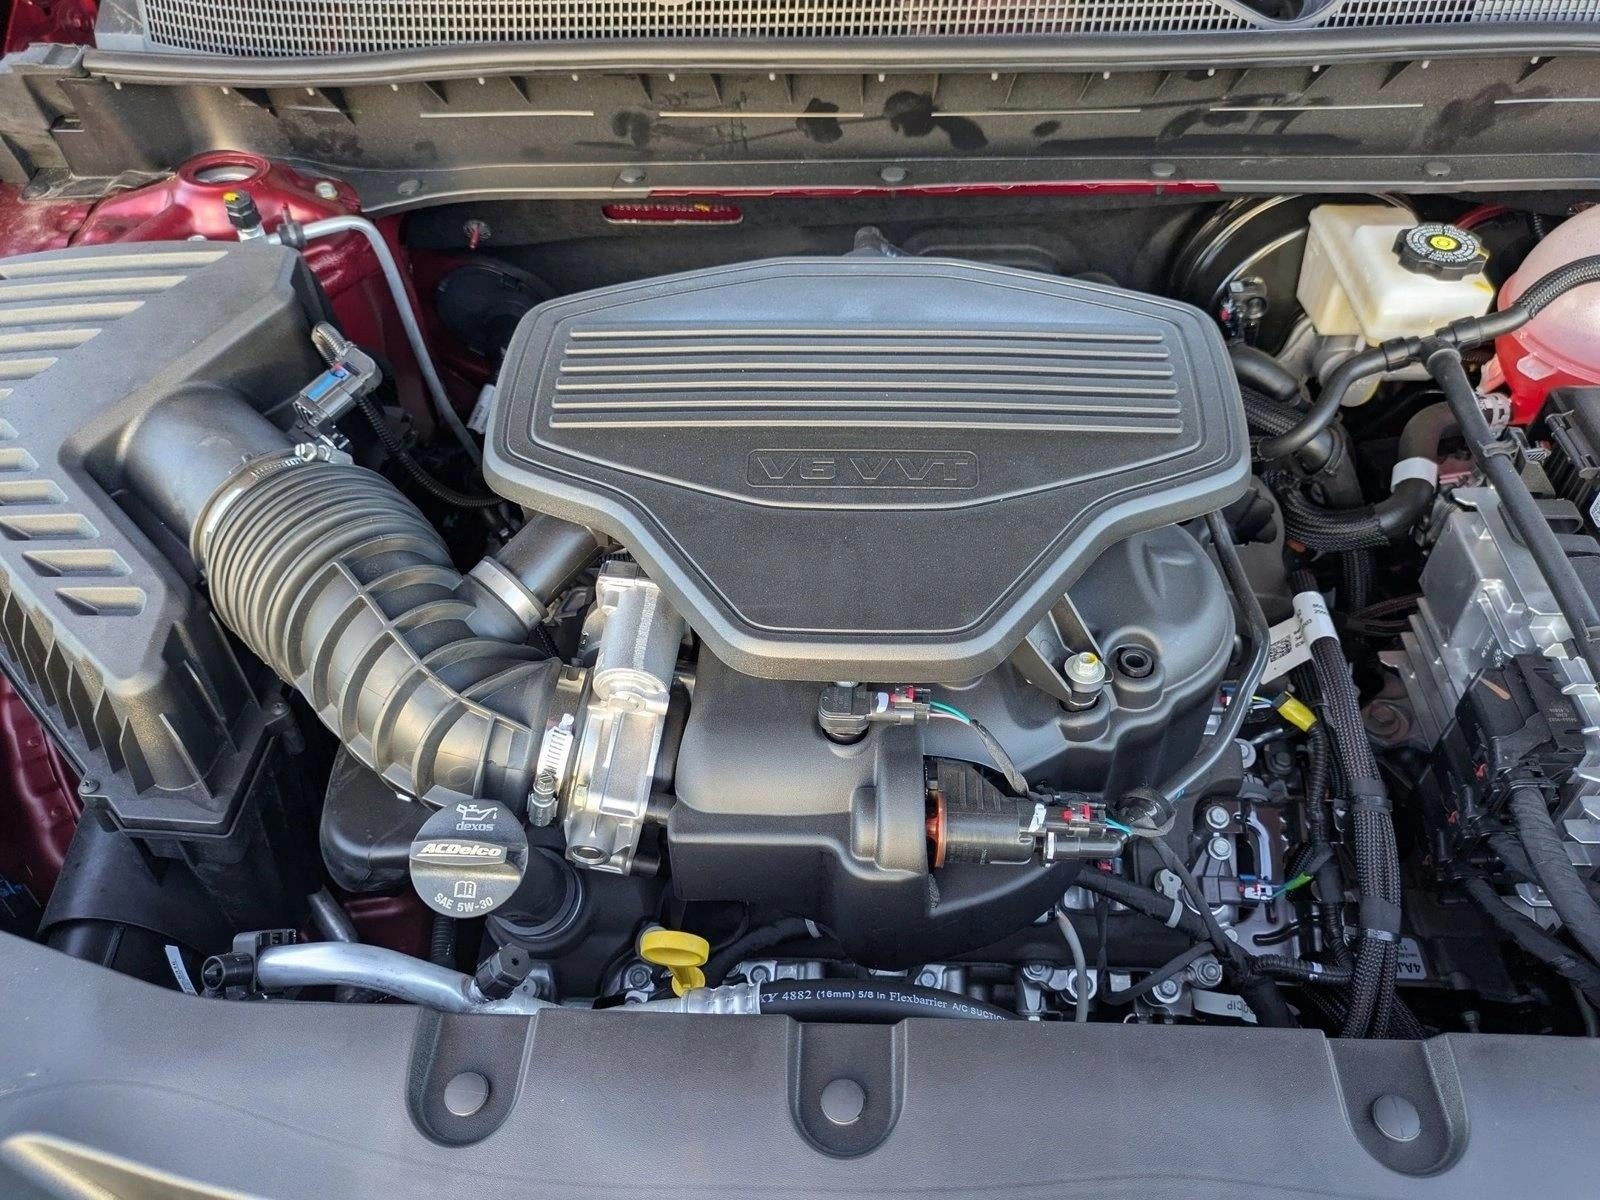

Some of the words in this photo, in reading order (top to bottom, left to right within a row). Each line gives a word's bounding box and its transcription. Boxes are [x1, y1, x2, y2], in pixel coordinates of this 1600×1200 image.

[757, 457, 836, 480] V6
[850, 457, 968, 481] VVT
[455, 822, 496, 832] dexos
[420, 842, 503, 857] ACDelco
[434, 892, 454, 910] SAE
[457, 896, 494, 912] 5W-30
[782, 989, 812, 1000] 4882
[816, 989, 855, 1000] (16mm)
[858, 990, 874, 999] 5/8
[889, 991, 948, 1009] Flexbarrier
[952, 1002, 968, 1013] A/C
